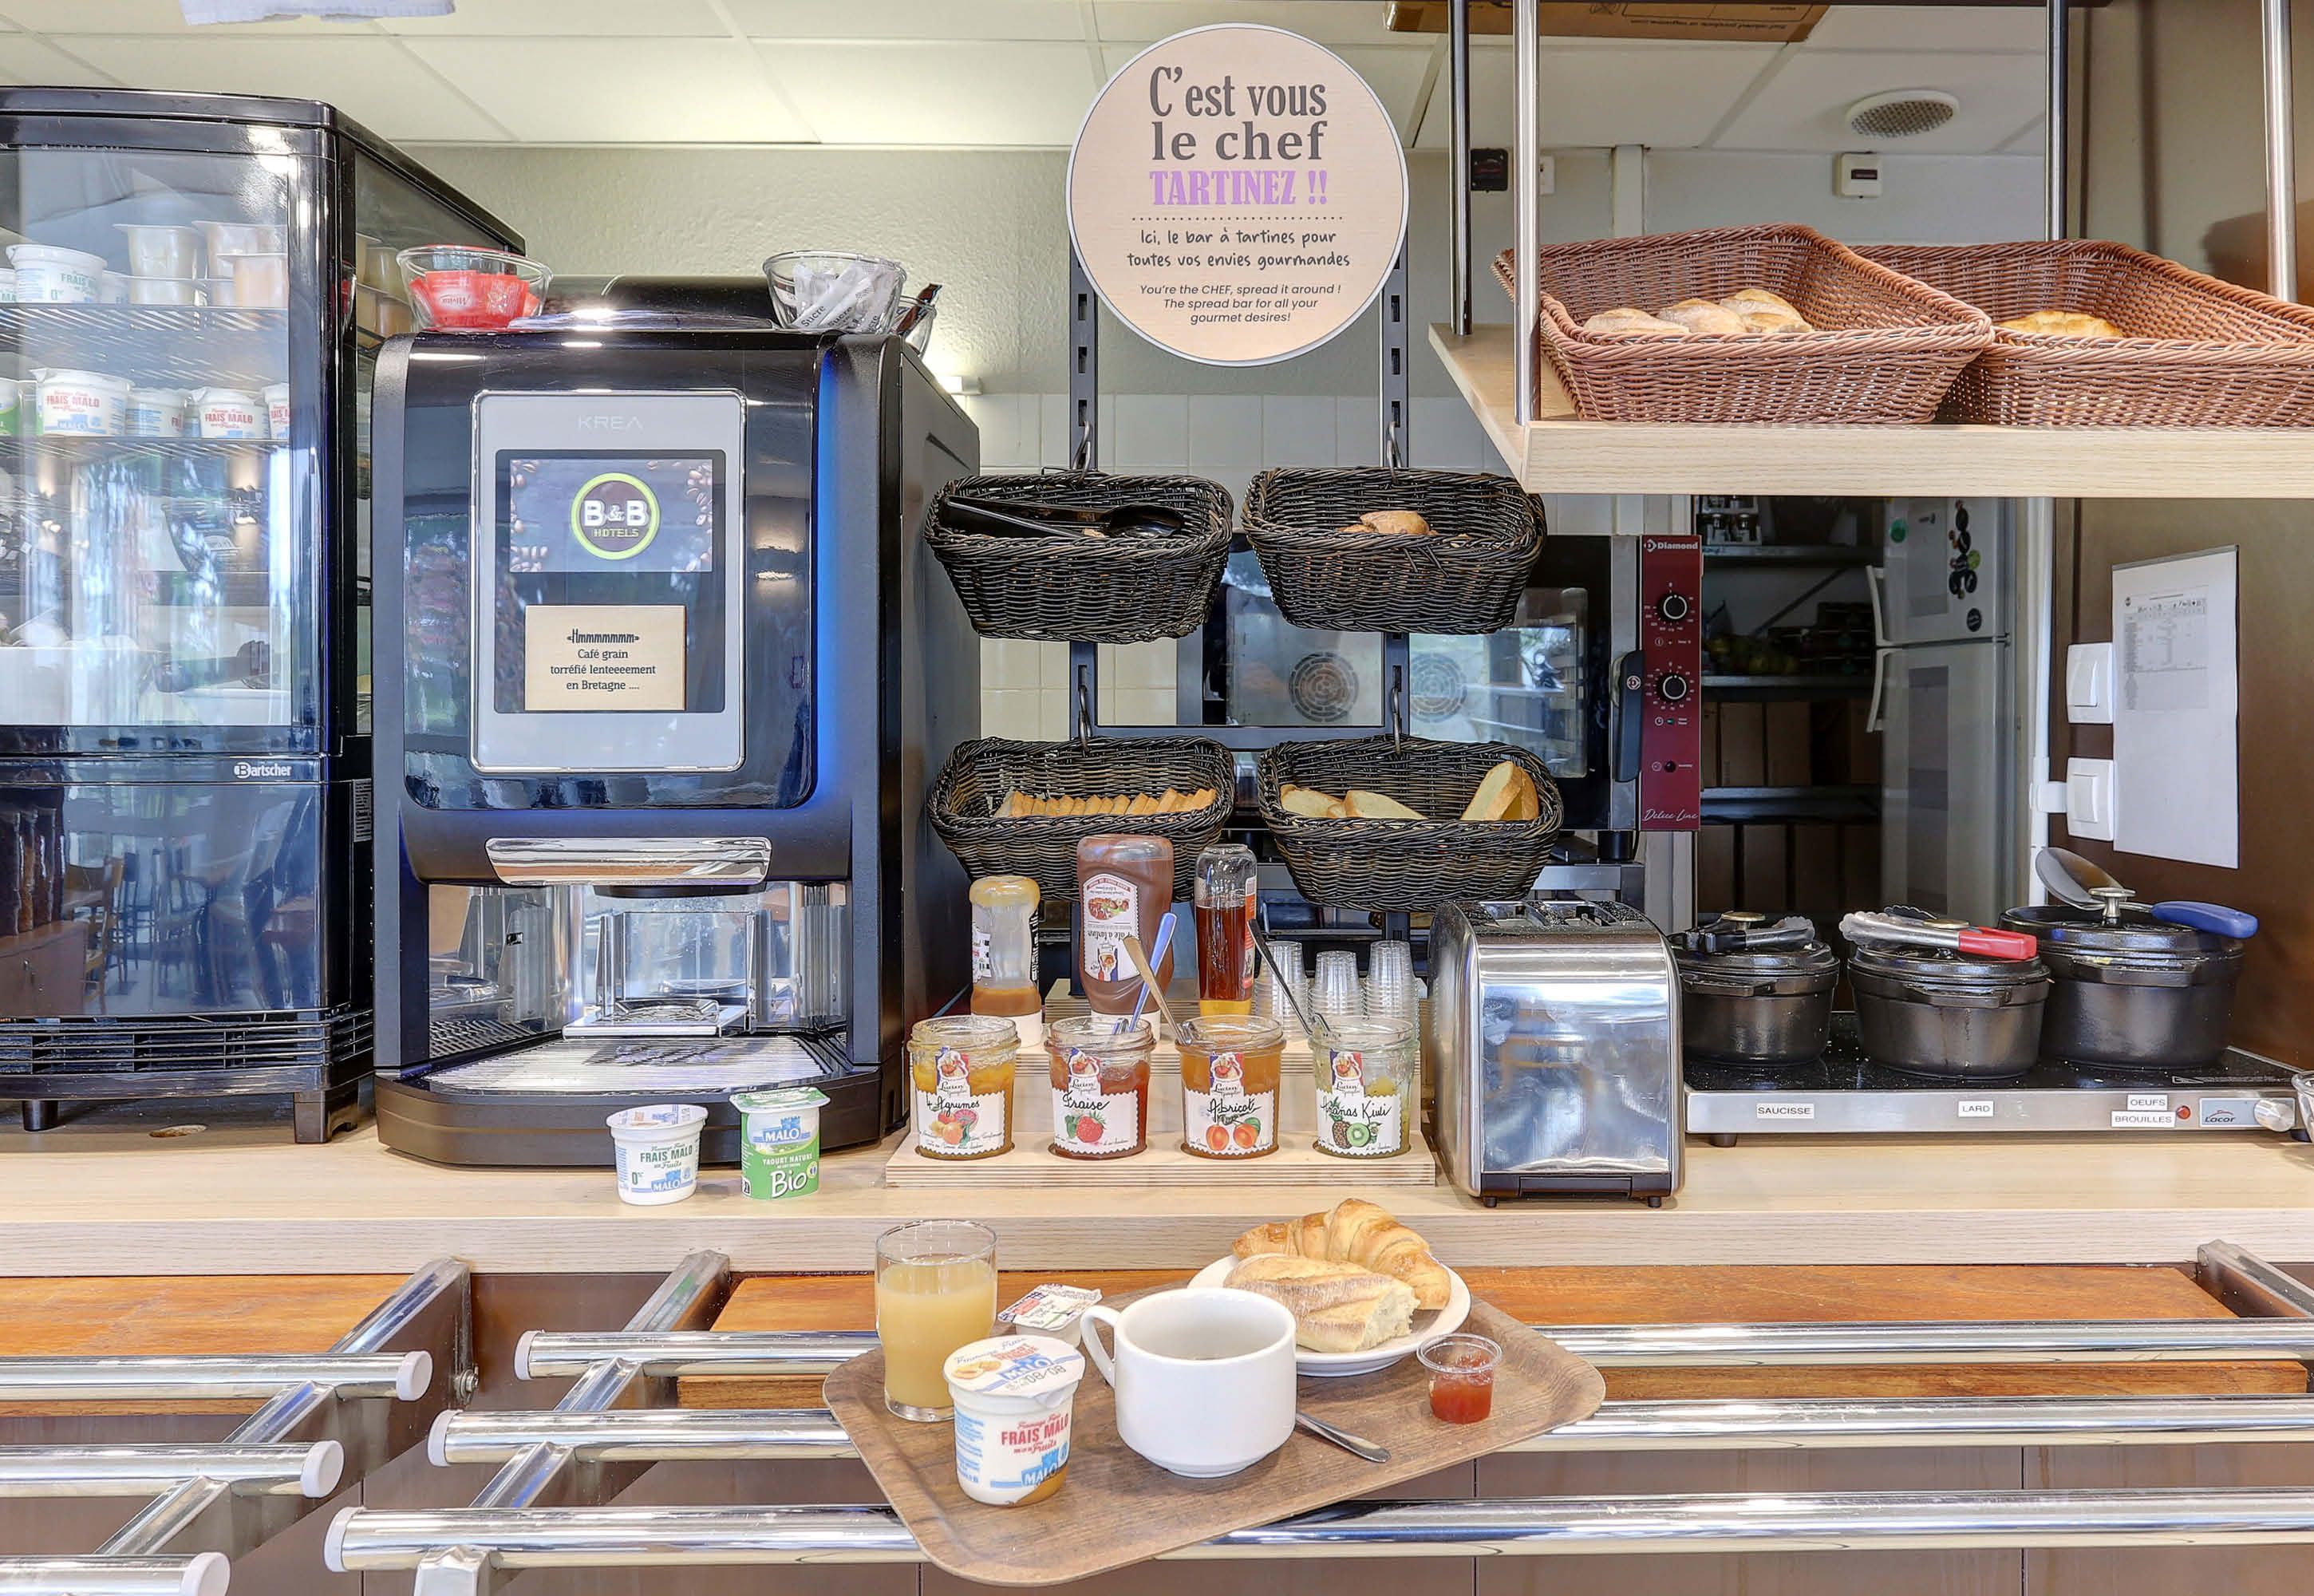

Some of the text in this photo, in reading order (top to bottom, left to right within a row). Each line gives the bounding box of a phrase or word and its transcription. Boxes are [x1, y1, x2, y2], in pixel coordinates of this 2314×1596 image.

[1246, 83, 1327, 117] vous
[1151, 120, 1328, 160] le chef
[1149, 170, 1328, 205] TARTINEZ !!
[1140, 227, 1337, 248] Ici, le bar à tartines pour
[1127, 251, 1350, 271] toutes vos envies gourmandes
[1179, 283, 1198, 295] the
[1201, 284, 1234, 296] CHEF,
[1236, 283, 1277, 297] spread
[1280, 283, 1289, 294] it
[1292, 284, 1334, 294] around
[1164, 298, 1318, 311] The spread bar for all your
[800, 305, 825, 327] Sucre
[827, 306, 852, 327] Sucre
[1190, 312, 1291, 326] gourmet desires!
[46, 395, 100, 408] FRAIS MALO
[204, 413, 254, 425] FRAIS MALO
[583, 499, 649, 527] B&B
[593, 527, 639, 538] HOTELS
[1657, 541, 1699, 551] Diamond
[577, 648, 629, 662] Café grain
[550, 664, 656, 675] torréfié lenteeeement
[566, 681, 578, 690] en
[582, 680, 626, 693] Bretagne
[233, 761, 293, 779] Bartscher
[934, 1096, 980, 1117] Agrumes
[1062, 1090, 1110, 1110] Fraise
[1207, 1097, 1259, 1123] Abricot
[1758, 1106, 1811, 1116] SAUCISSE
[1962, 1104, 1991, 1113] LARD
[2115, 1115, 2172, 1124] BROUILLES
[766, 1128, 800, 1142] MALO
[640, 1144, 693, 1163] FRAIS MALO
[762, 1156, 788, 1166] YAOURT
[654, 1179, 681, 1192] MALO
[770, 1169, 808, 1199] Bio
[1001, 1412, 1068, 1446] FRAIS MALO
[1024, 1462, 1058, 1487] MALO
